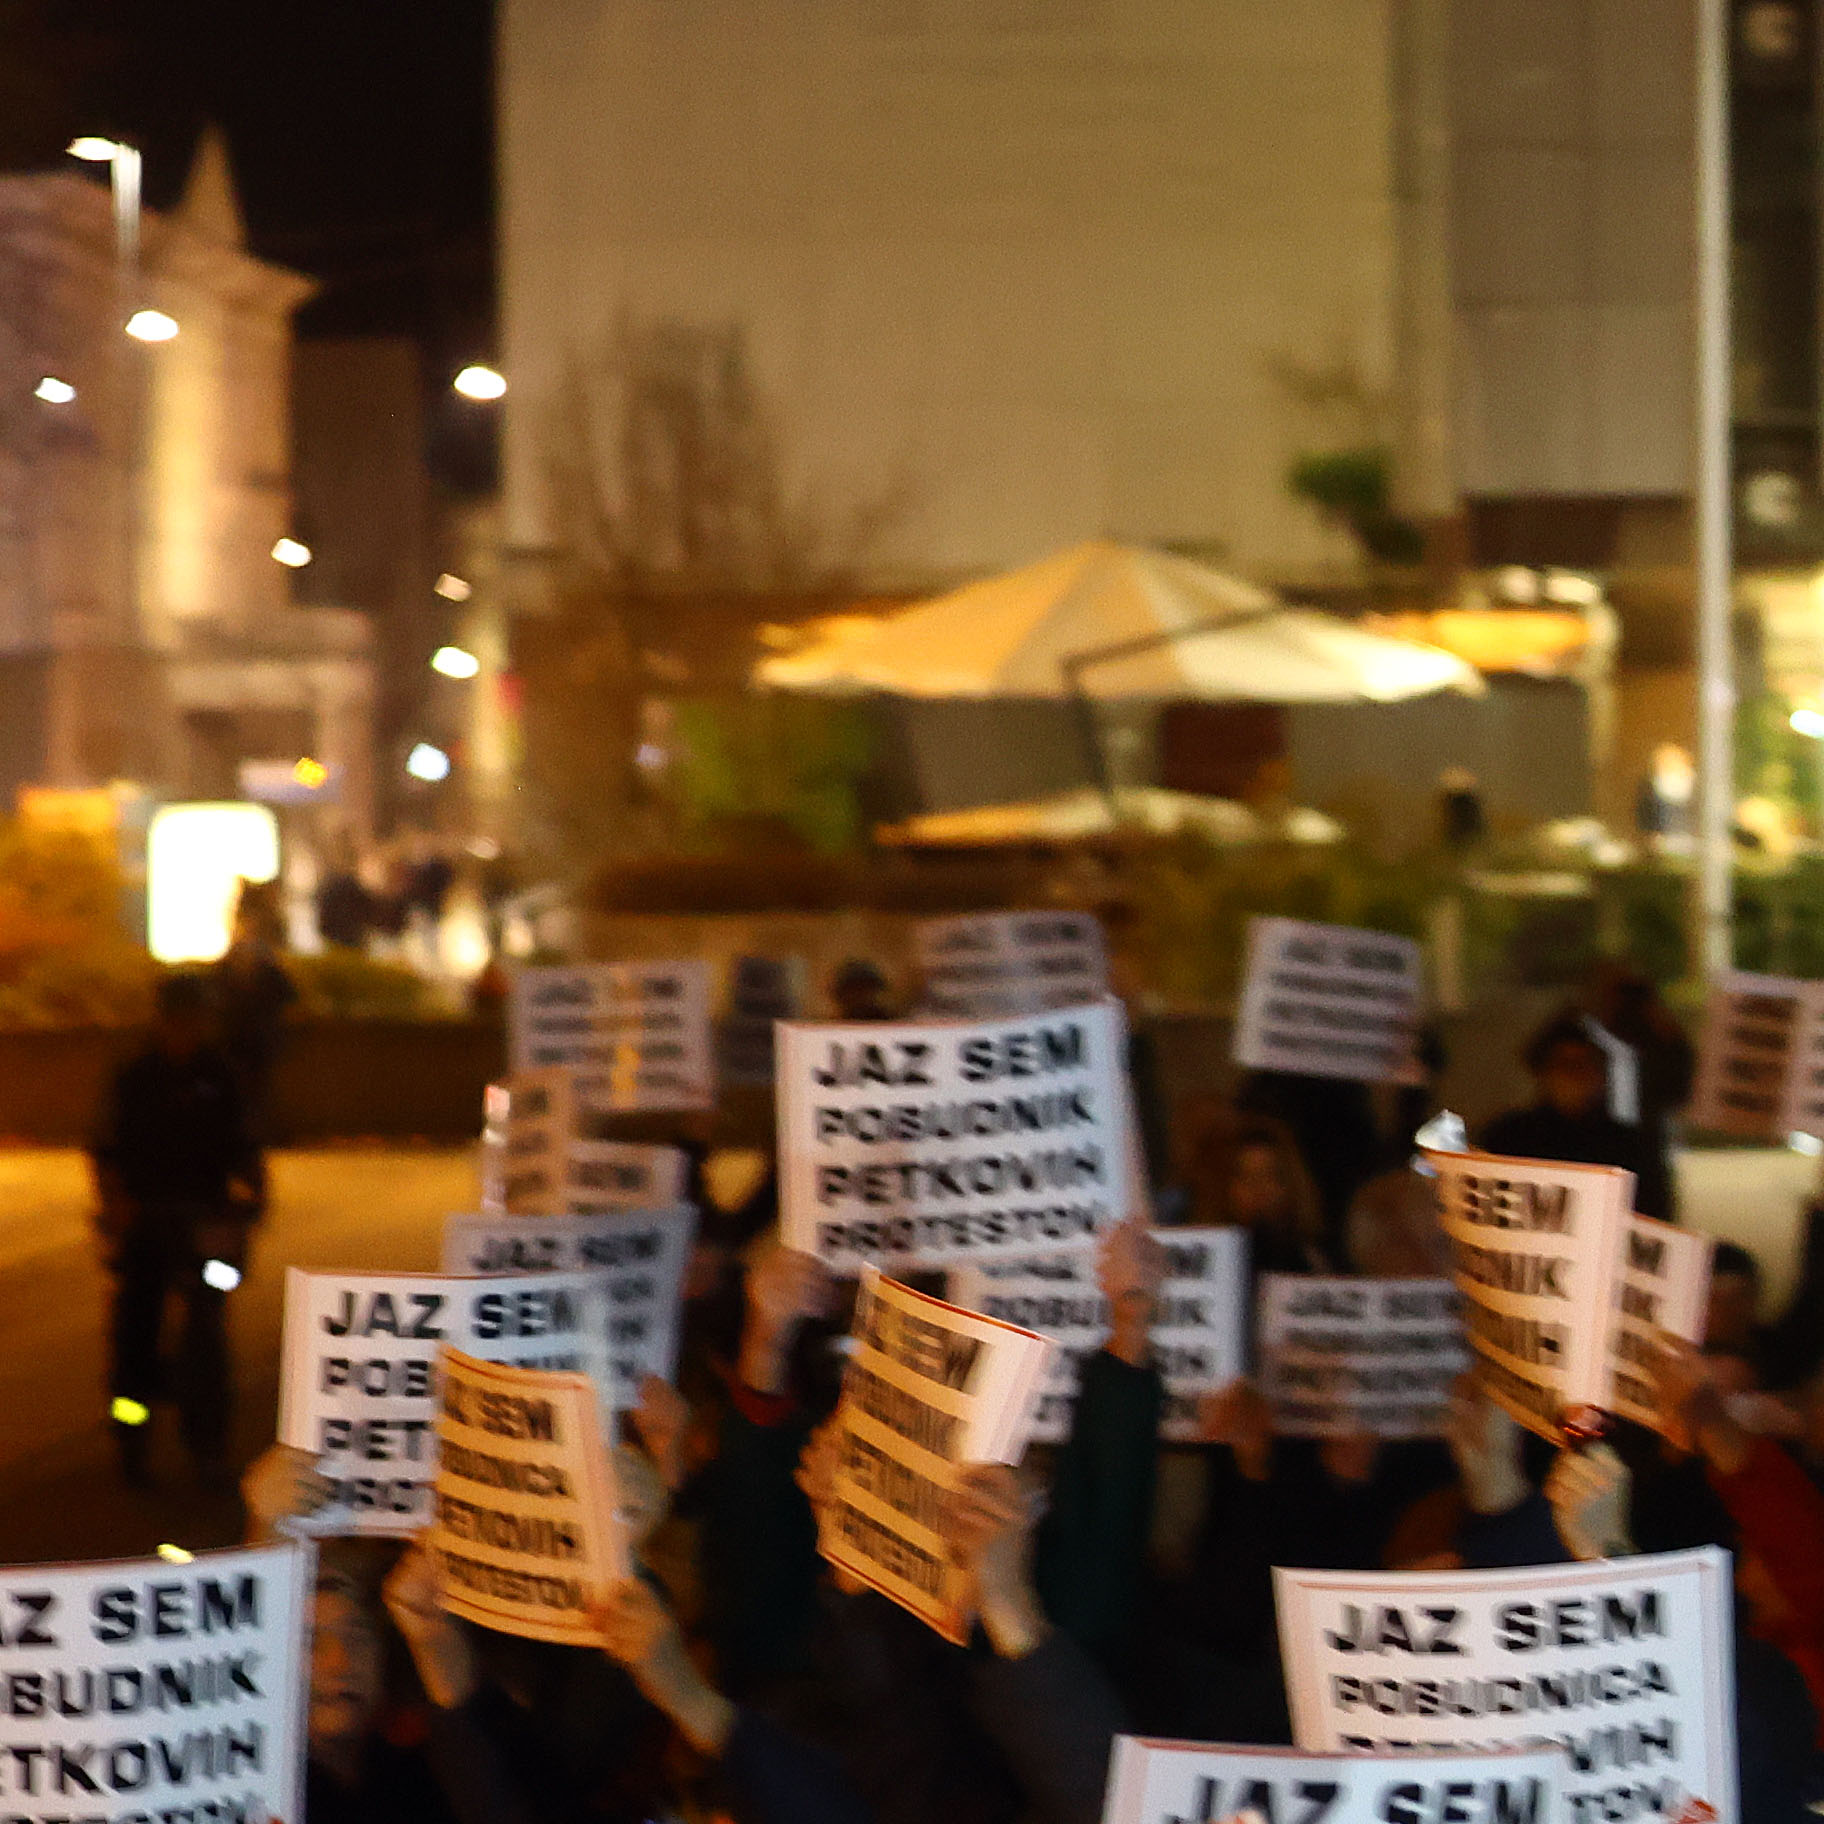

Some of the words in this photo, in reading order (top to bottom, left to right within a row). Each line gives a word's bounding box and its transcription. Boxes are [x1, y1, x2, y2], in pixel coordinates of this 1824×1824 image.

[815, 1038, 935, 1088] JAZ
[960, 1022, 1087, 1082] SEM
[817, 1088, 1096, 1145] POBUDNIK
[820, 1147, 1107, 1205] PETKOVIH
[1461, 1171, 1571, 1235] SEM
[322, 1290, 446, 1340] JAZ
[470, 1291, 580, 1341] SEM
[91, 1570, 262, 1644] SEM
[1323, 1602, 1470, 1657] JAZ
[1493, 1589, 1673, 1654] SEM
[0, 1648, 268, 1719] BUDNIK
[1332, 1658, 1678, 1718] POBUDNICA
[0, 1717, 264, 1799] TKOVIH
